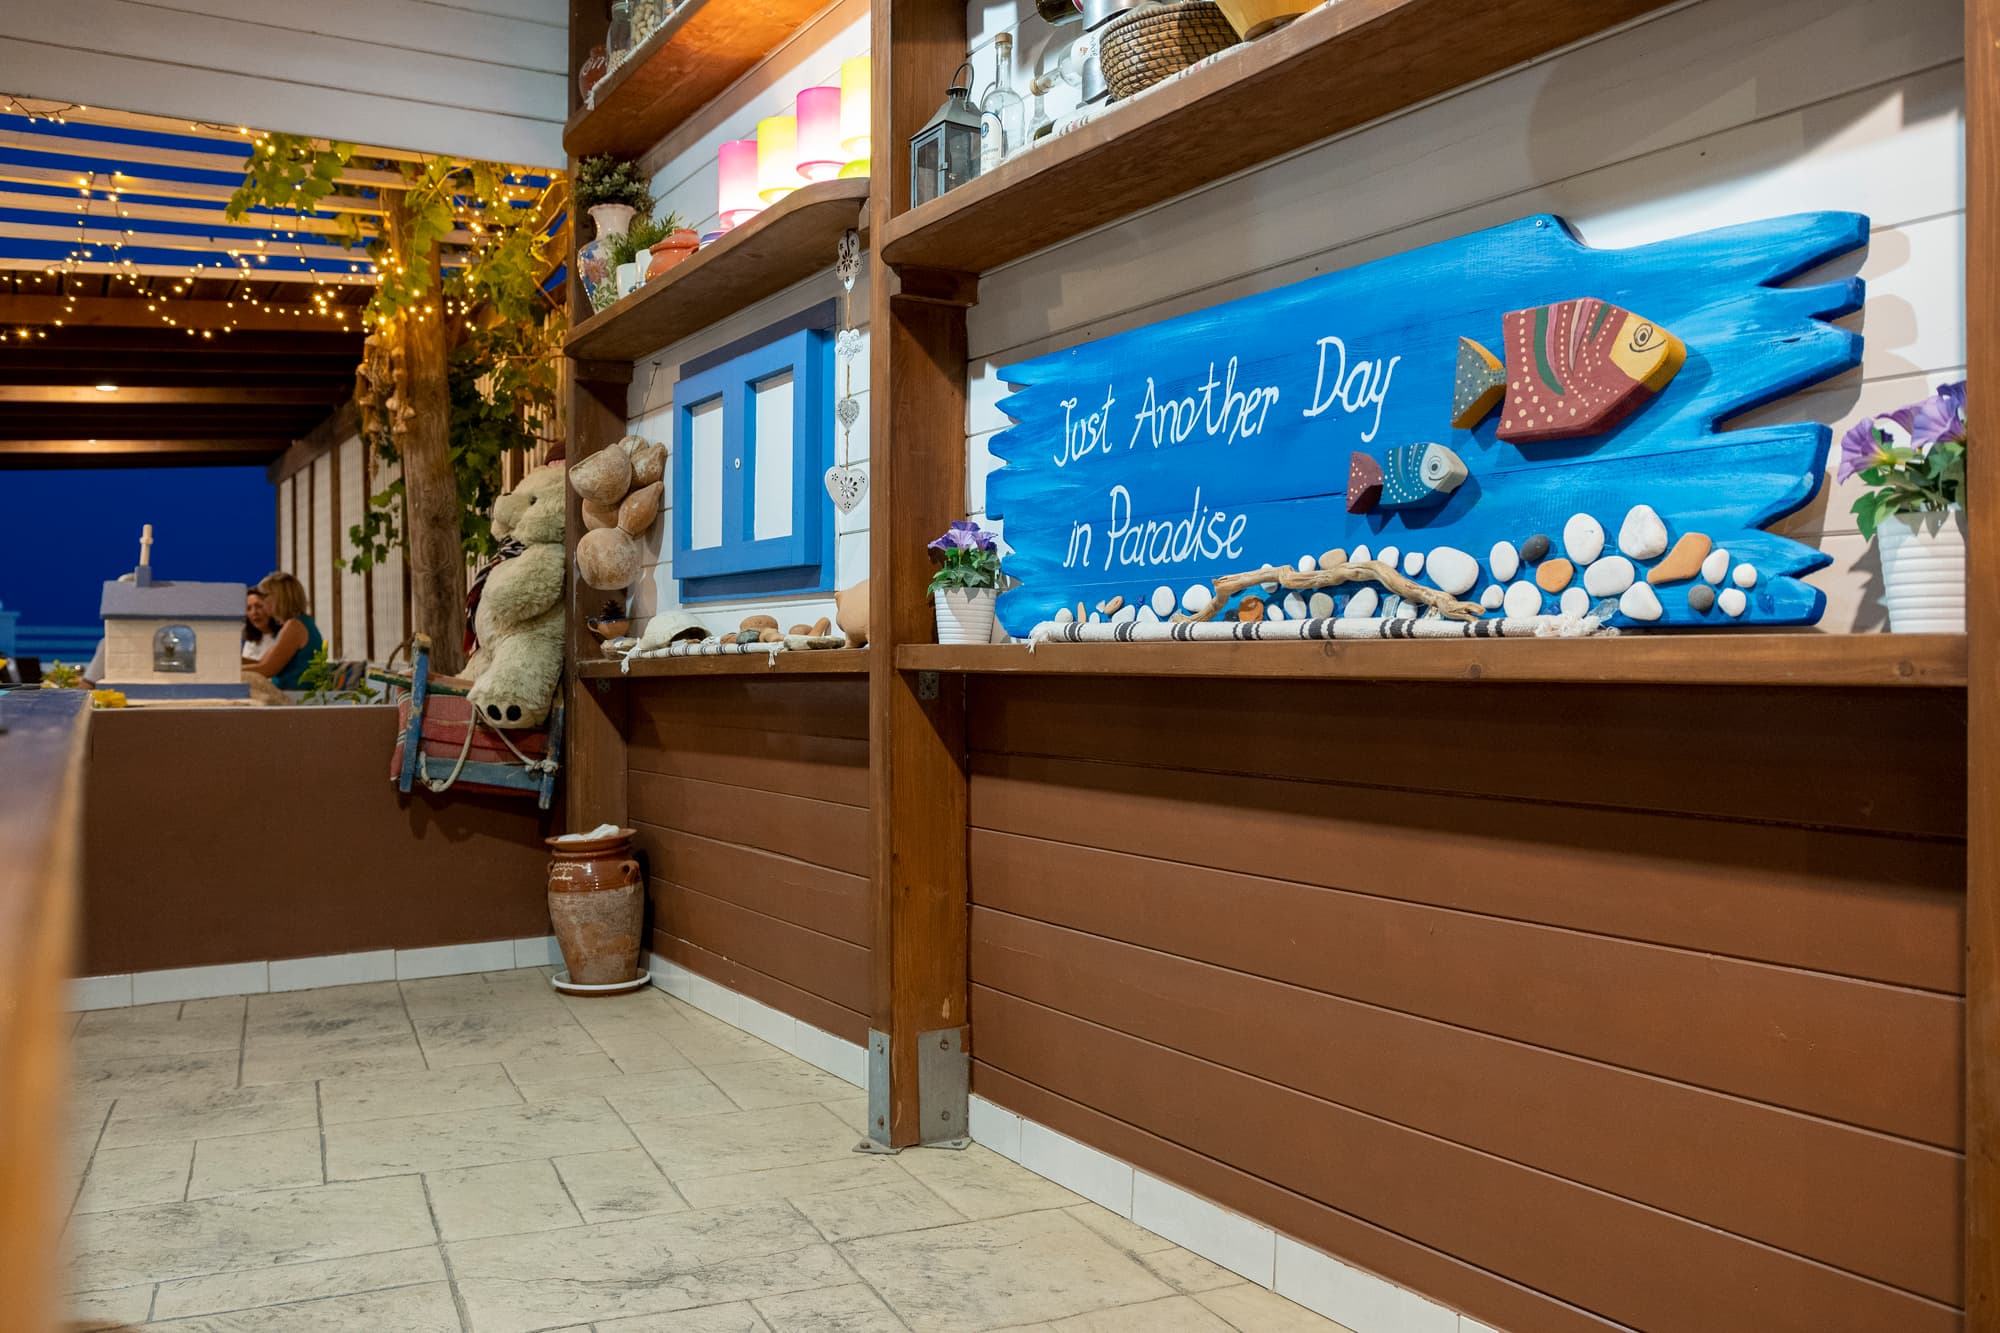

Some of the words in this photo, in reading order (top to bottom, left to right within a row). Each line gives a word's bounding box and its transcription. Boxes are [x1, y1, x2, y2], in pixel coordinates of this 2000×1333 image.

[1053, 384, 1116, 467] Just
[1129, 356, 1280, 448] Another
[1303, 336, 1401, 443] Day
[1062, 520, 1092, 568] in
[1104, 485, 1248, 572] Paradise
